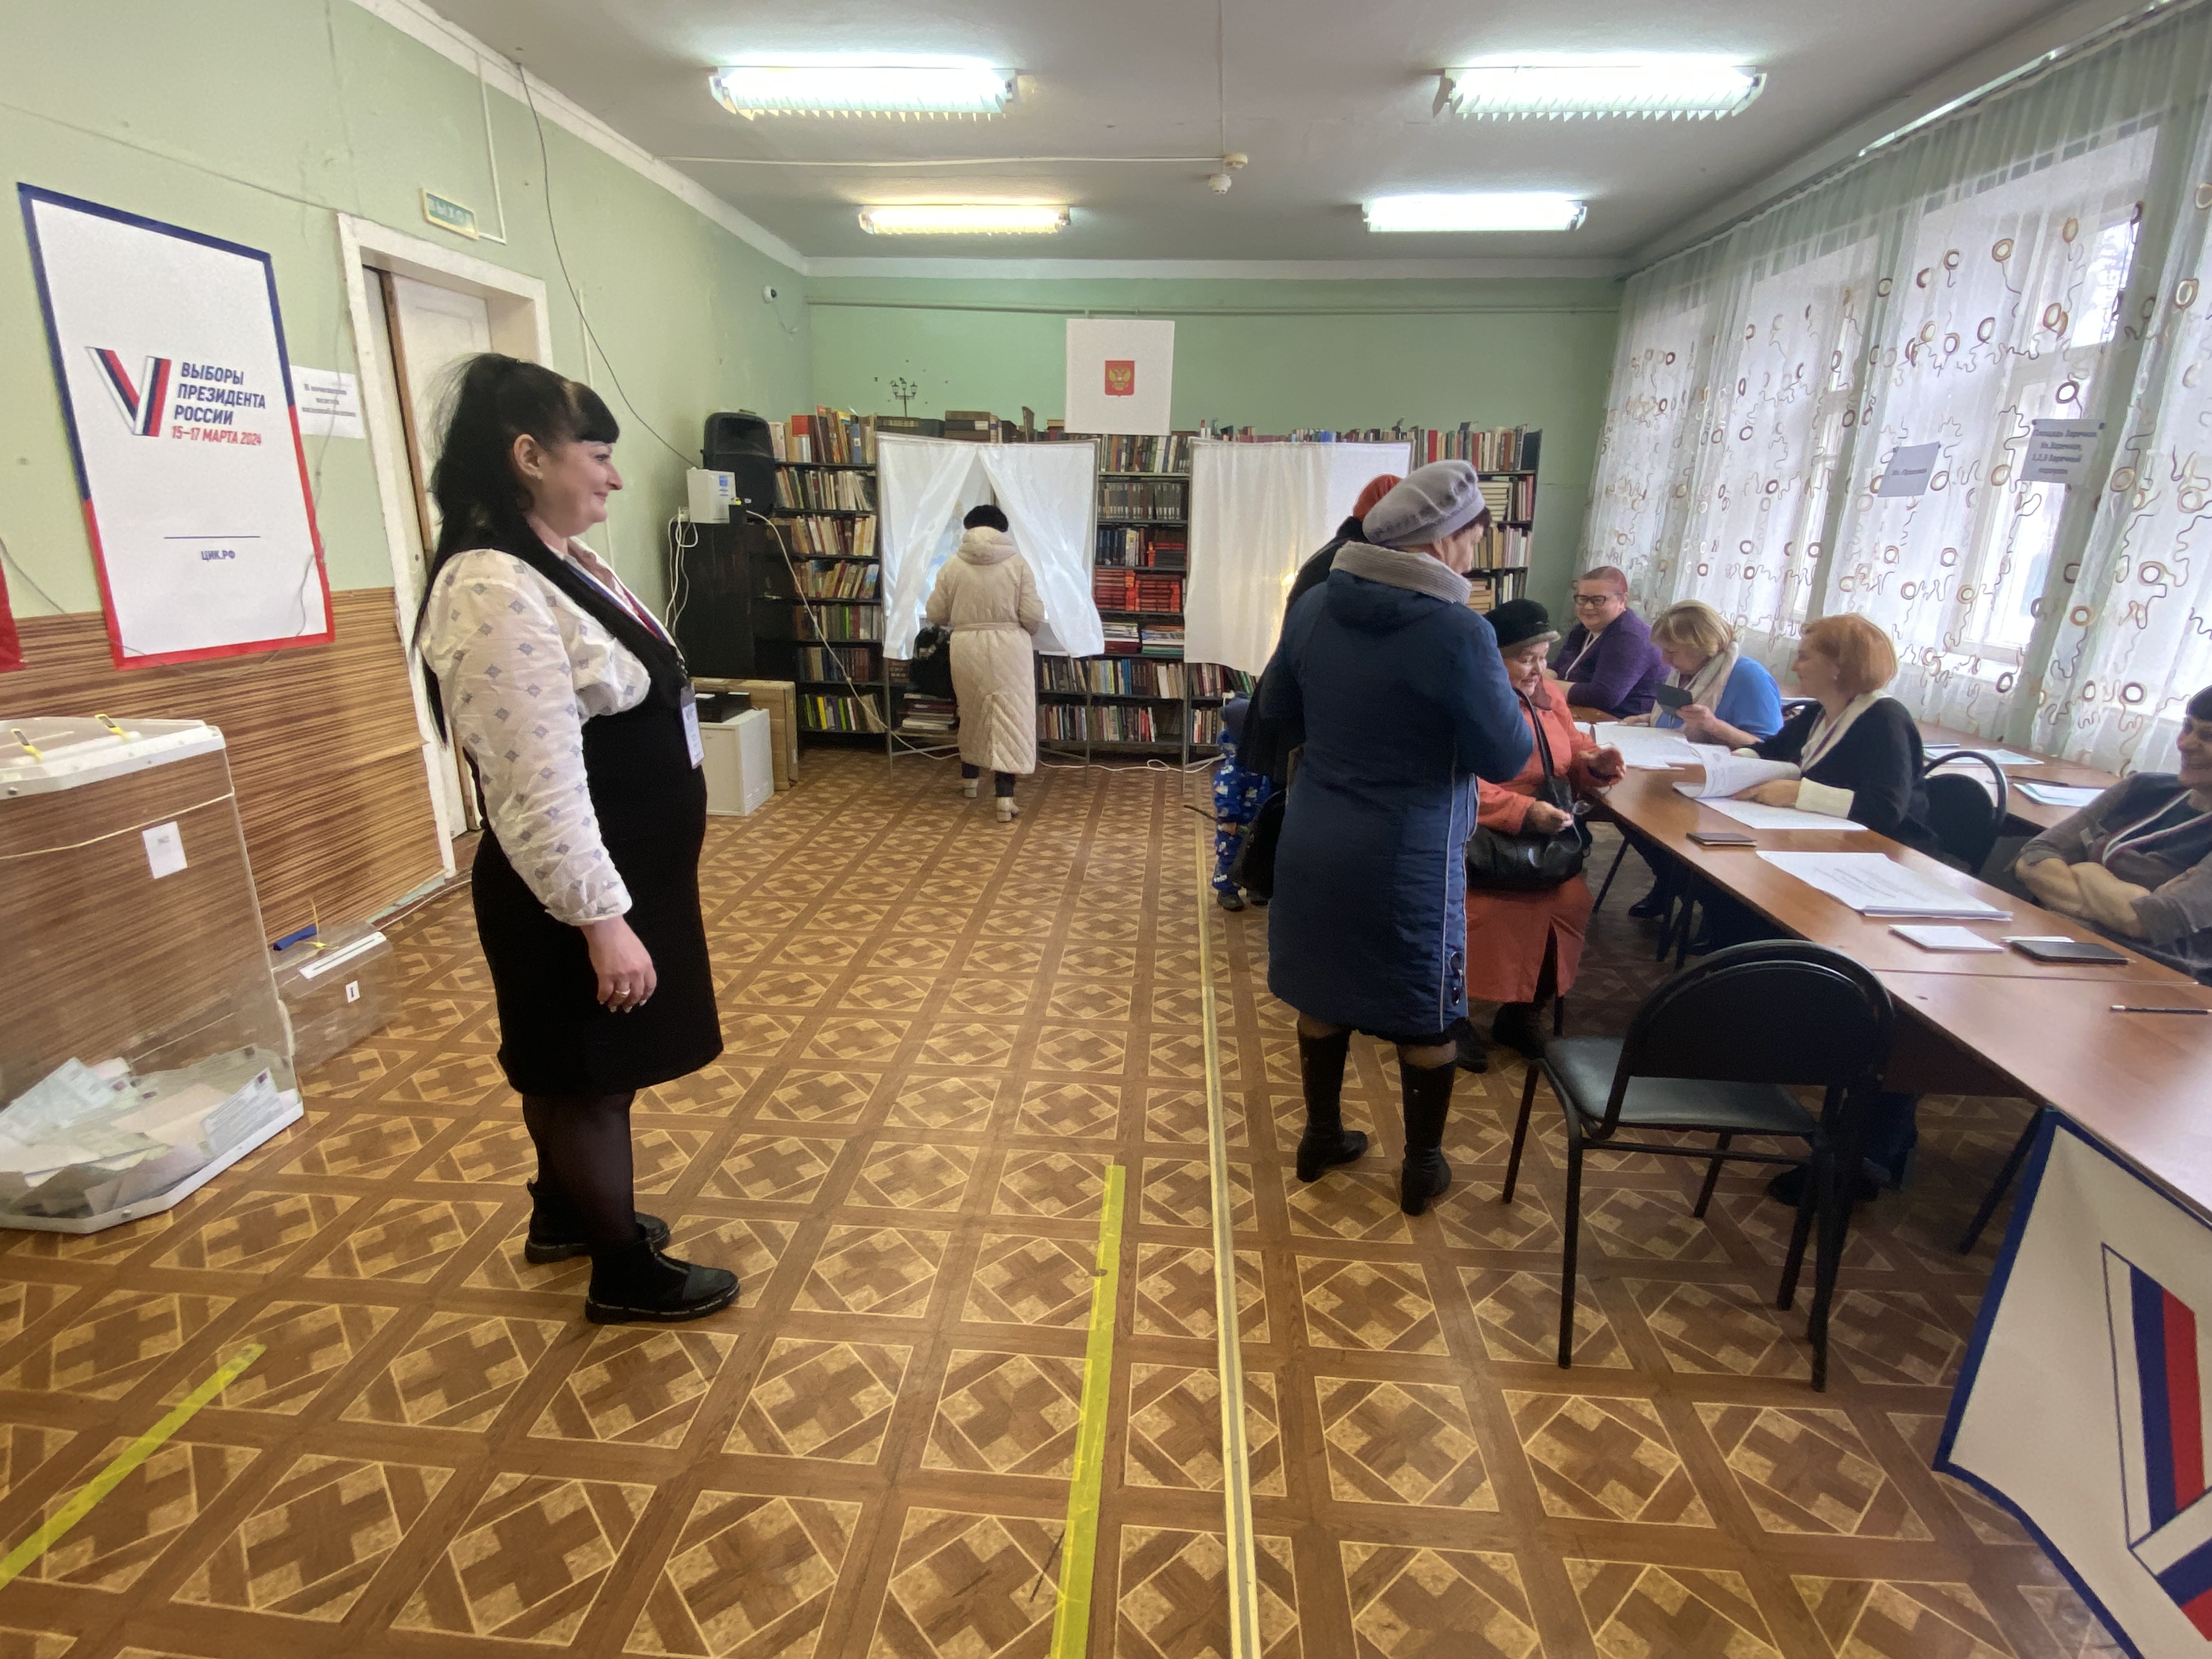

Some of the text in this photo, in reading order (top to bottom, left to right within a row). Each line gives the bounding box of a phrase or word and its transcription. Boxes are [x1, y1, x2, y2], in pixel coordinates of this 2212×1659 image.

[181, 362, 244, 385] ВЫБОРЫ
[177, 383, 266, 409] ПРЕЗИДЕНТА
[174, 404, 234, 425] РОССИИ
[202, 428, 238, 444] МАРТА
